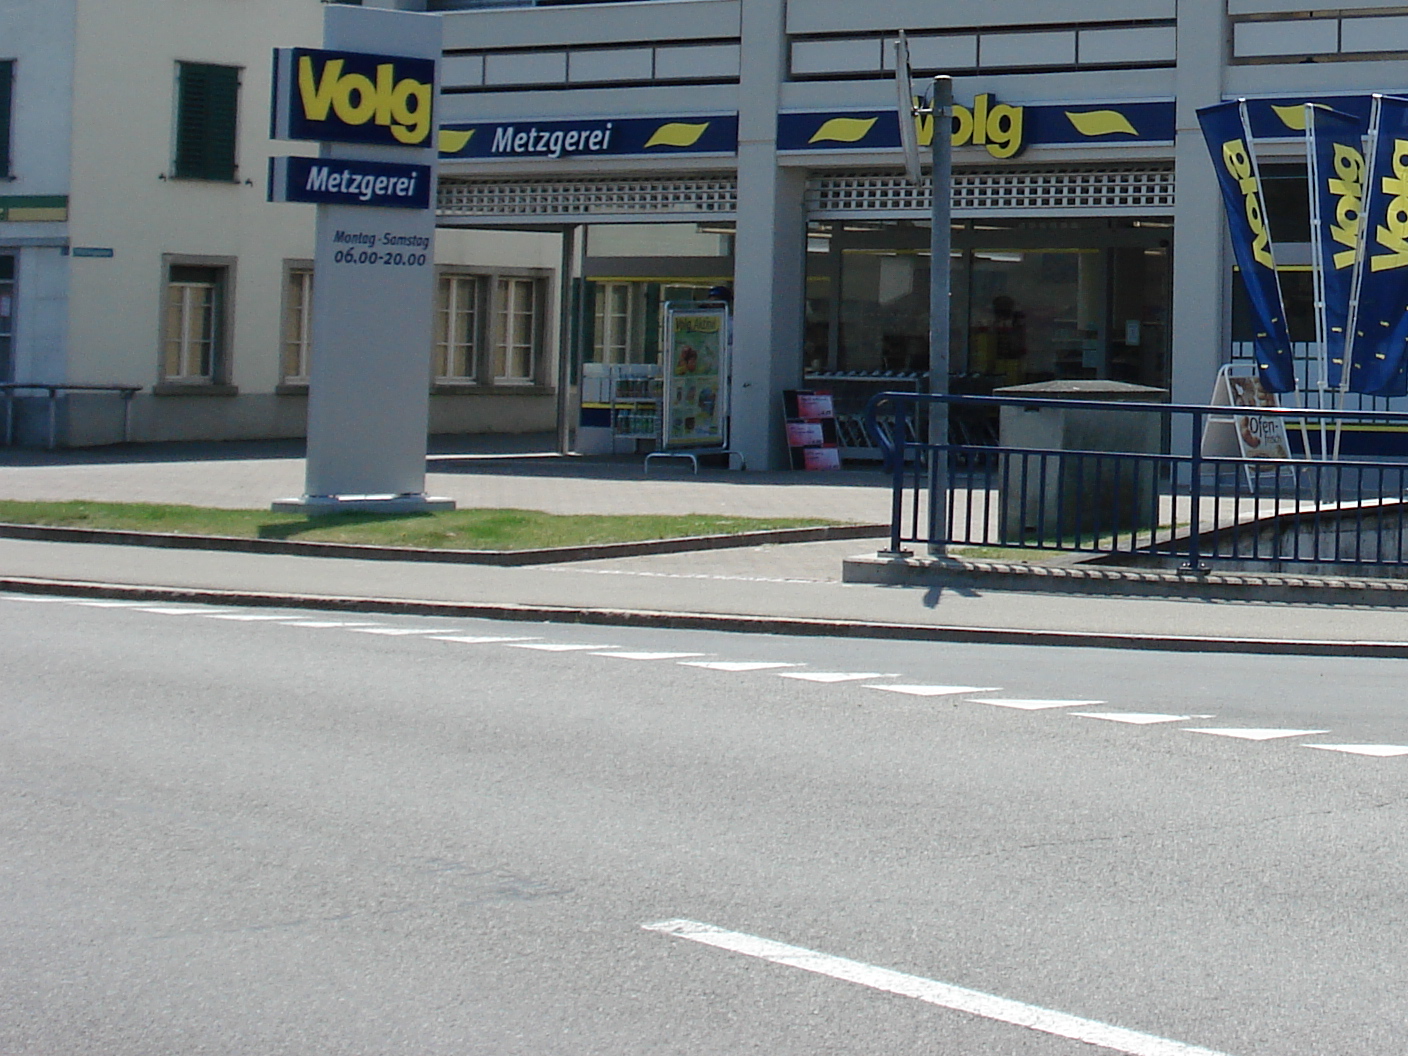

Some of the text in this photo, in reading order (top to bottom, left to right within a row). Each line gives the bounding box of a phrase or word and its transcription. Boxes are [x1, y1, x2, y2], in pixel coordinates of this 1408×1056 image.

[299, 55, 432, 144] Volg
[491, 123, 613, 159] Metzgerei
[306, 166, 417, 201] Metzgerei
[1328, 142, 1366, 270] Volg
